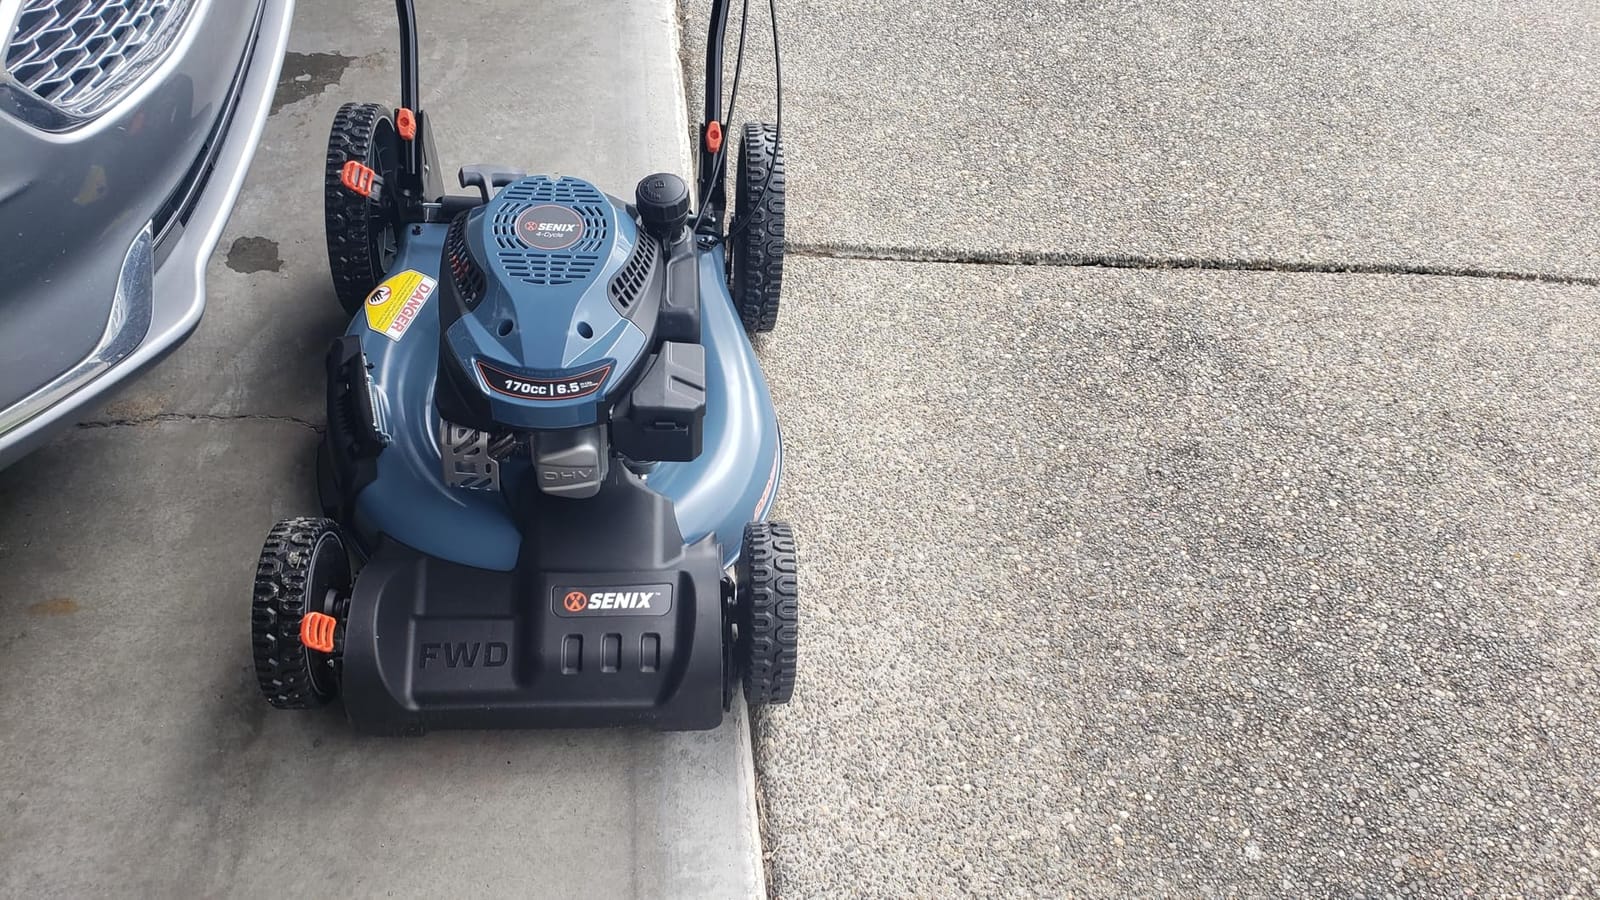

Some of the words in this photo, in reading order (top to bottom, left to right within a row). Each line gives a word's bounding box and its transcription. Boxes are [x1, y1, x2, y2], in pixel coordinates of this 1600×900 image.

[535, 231, 564, 239] 4-Cycle
[537, 222, 575, 232] SENIX
[391, 283, 431, 332] DANGER
[504, 379, 547, 395] 170cc
[556, 382, 580, 394] 6.5
[587, 592, 654, 610] SENIX
[419, 641, 509, 669] FWD
